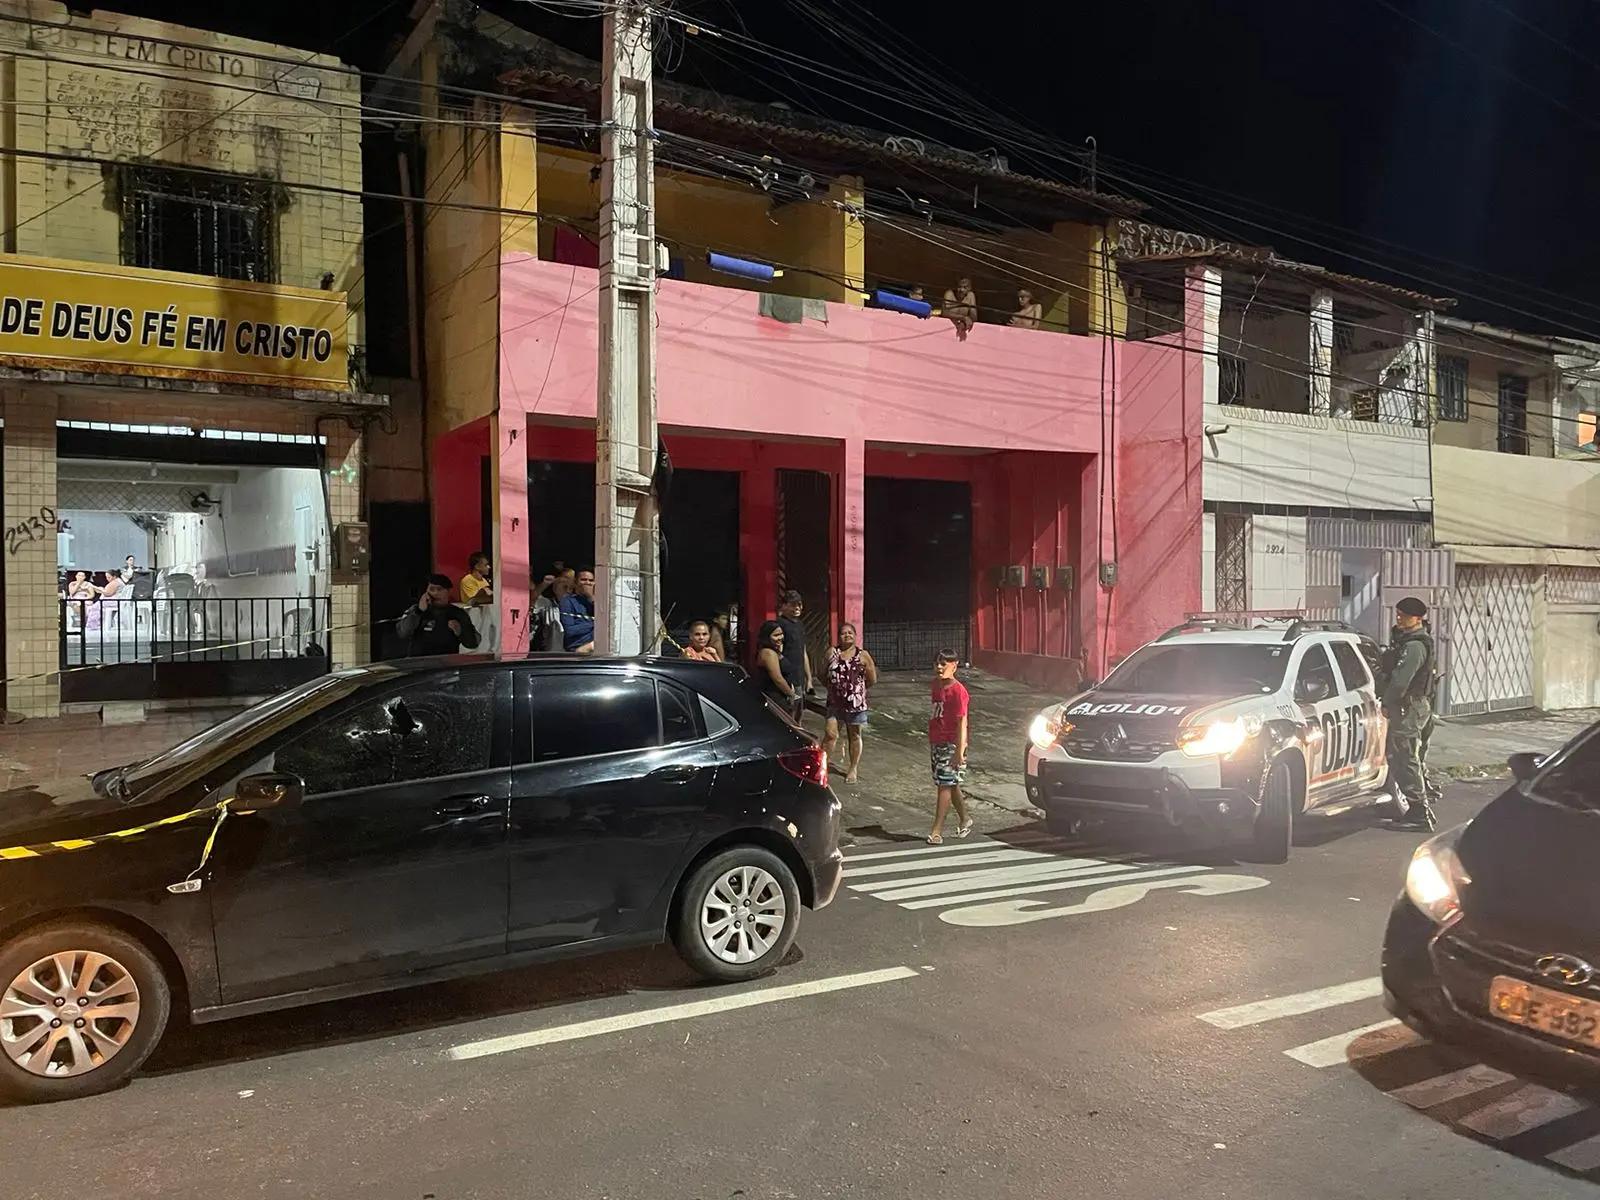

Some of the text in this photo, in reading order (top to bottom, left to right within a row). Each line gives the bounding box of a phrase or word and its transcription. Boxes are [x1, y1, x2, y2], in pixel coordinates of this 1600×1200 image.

[125, 37, 156, 62] EM
[168, 45, 244, 77] CRISTO
[1, 297, 332, 362] DE DEUS FÉ EM CRISTO
[5, 505, 56, 555] 2930
